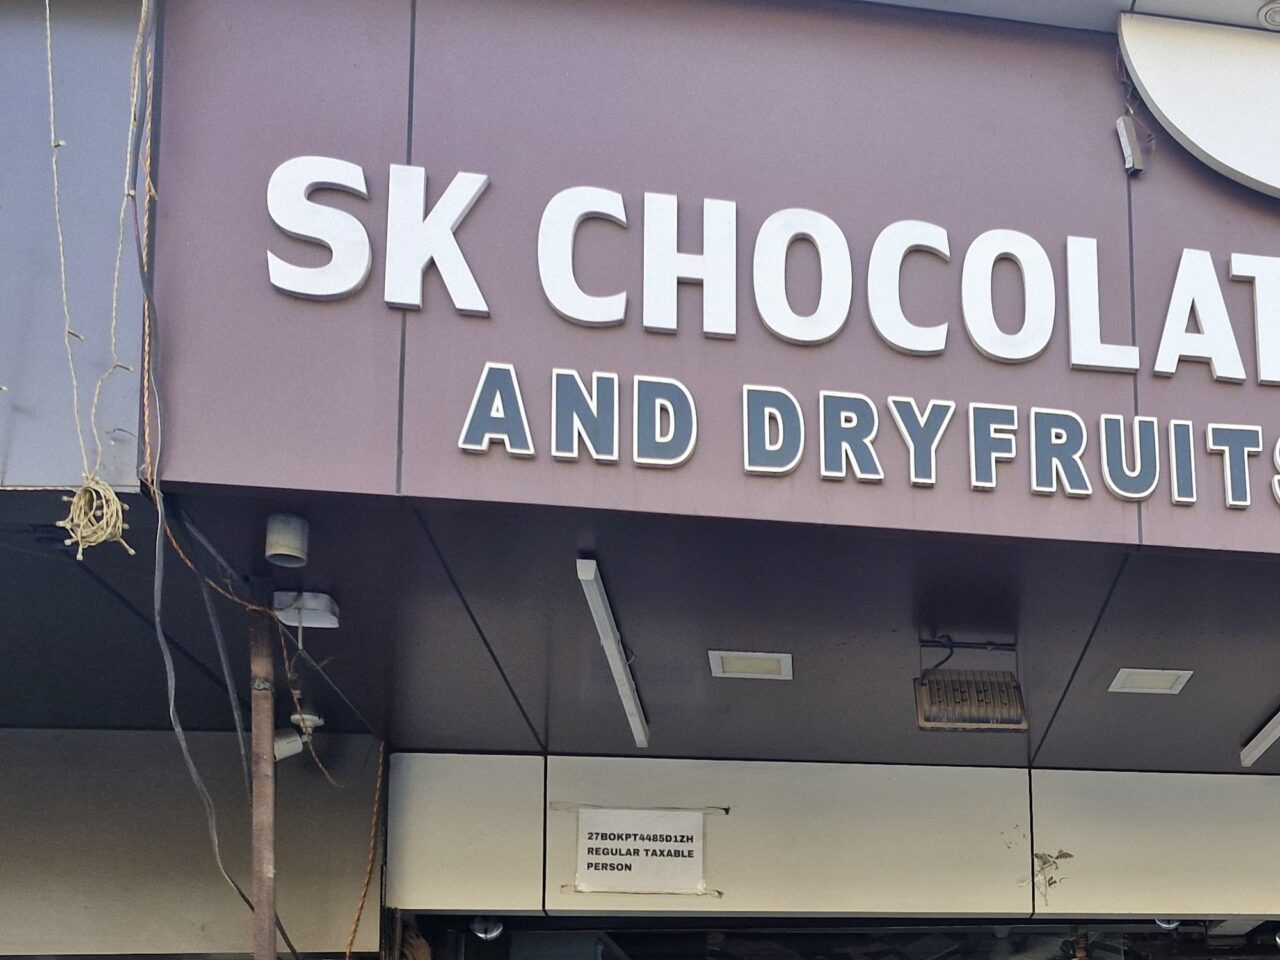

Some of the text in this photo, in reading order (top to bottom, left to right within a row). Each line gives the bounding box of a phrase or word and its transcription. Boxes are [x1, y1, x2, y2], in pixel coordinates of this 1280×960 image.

[266, 155, 491, 318] SK
[458, 361, 697, 469] AND
[586, 862, 632, 871] PERSON
[587, 847, 694, 858] REGULAR TAXABLE
